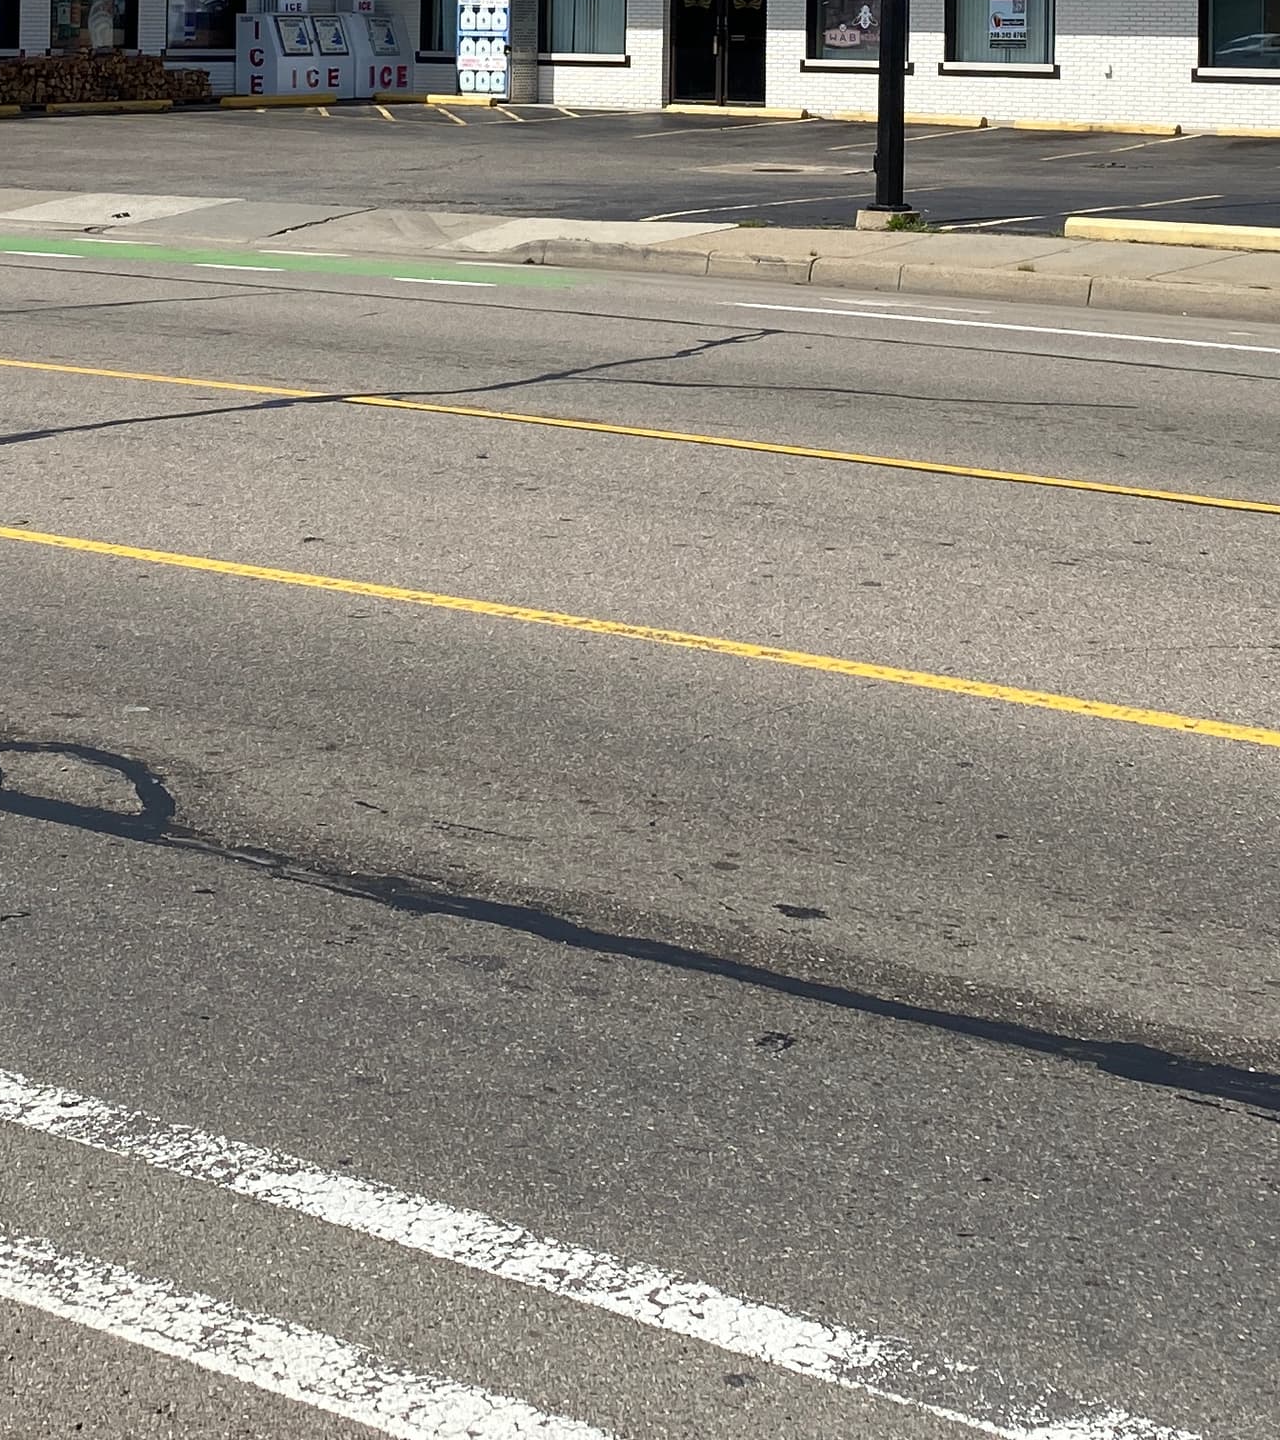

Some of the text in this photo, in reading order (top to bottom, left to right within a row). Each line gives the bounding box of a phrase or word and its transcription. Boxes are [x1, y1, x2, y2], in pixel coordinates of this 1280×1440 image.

[285, 3, 302, 11] ICE
[358, 1, 372, 10] ICE
[250, 21, 265, 95] ICE
[292, 67, 340, 88] ICE
[369, 65, 408, 89] ICE
